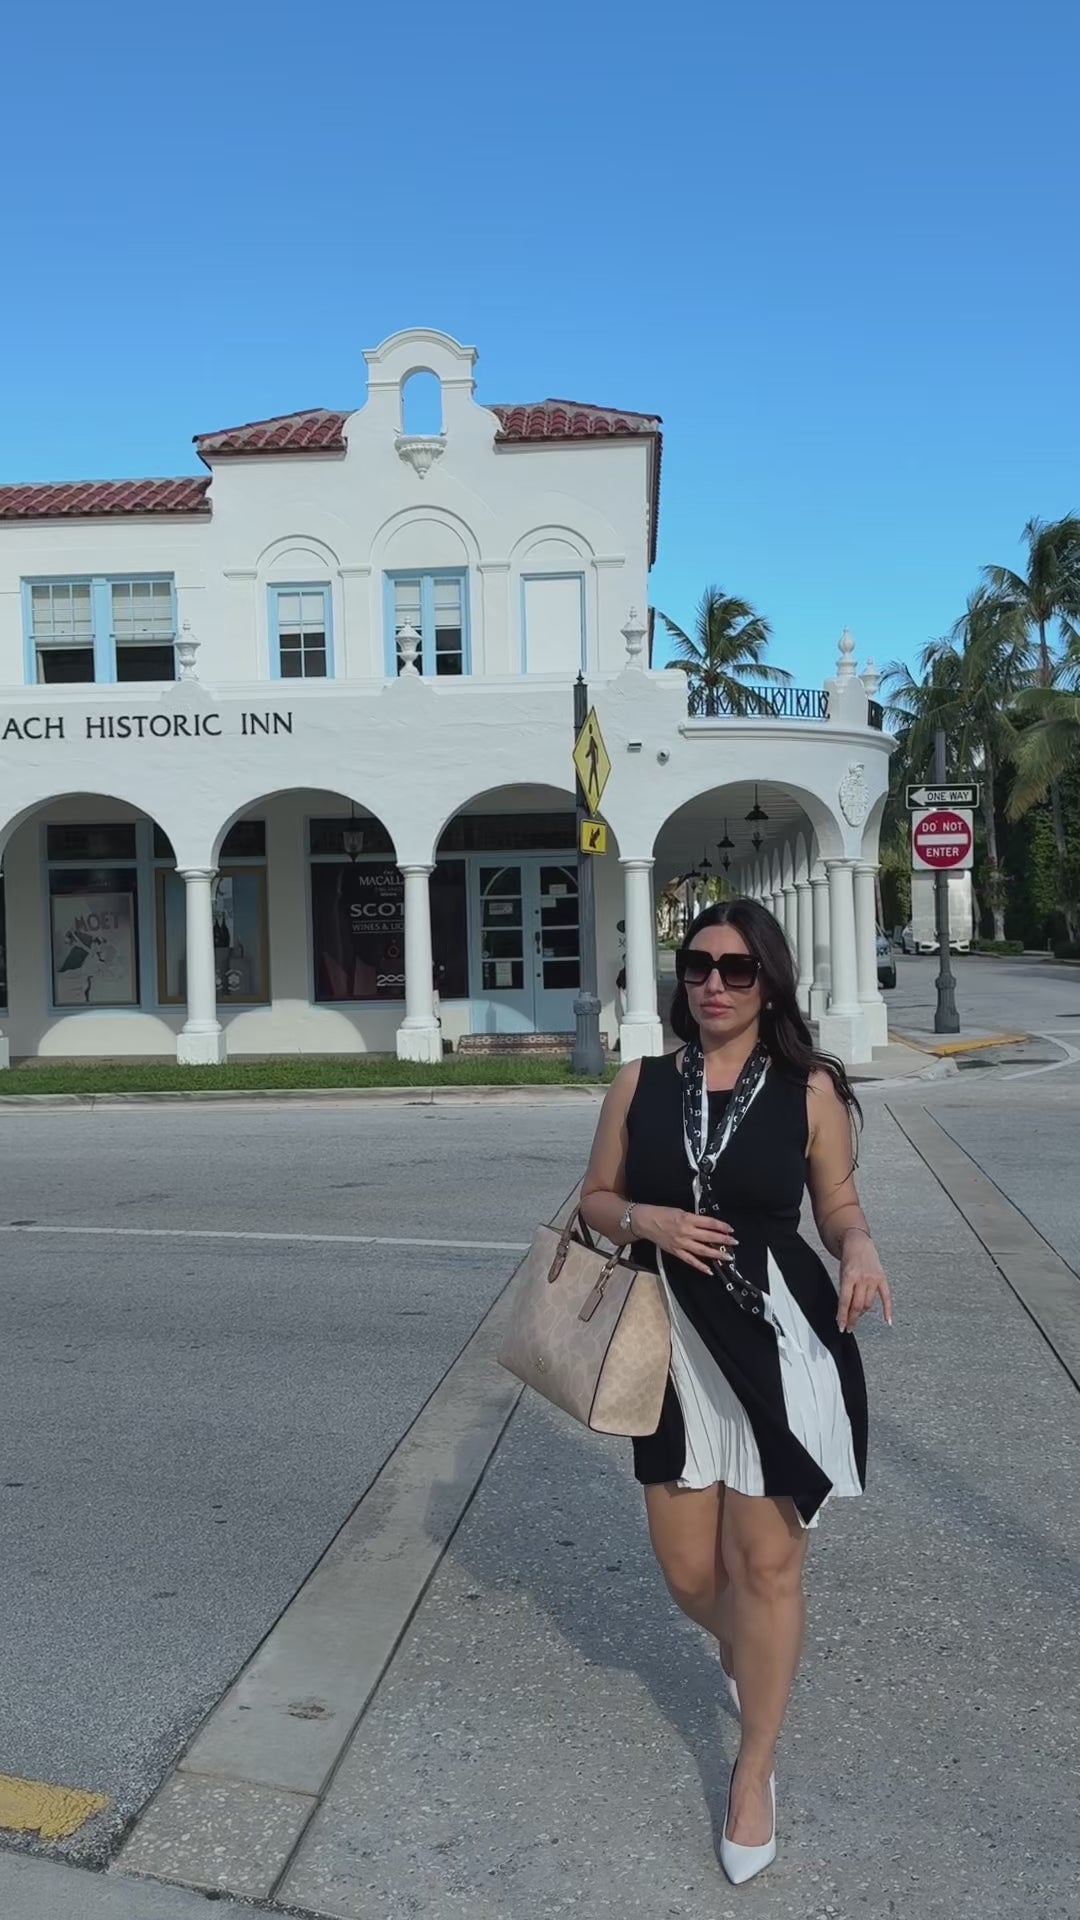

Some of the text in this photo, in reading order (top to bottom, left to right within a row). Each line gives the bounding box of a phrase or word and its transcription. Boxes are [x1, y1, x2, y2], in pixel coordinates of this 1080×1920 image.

[2, 712, 293, 740] ACH HISTORIC INN
[927, 791, 969, 801] ONE WAY
[922, 821, 964, 832] DO NOT
[926, 847, 959, 857] ENTER
